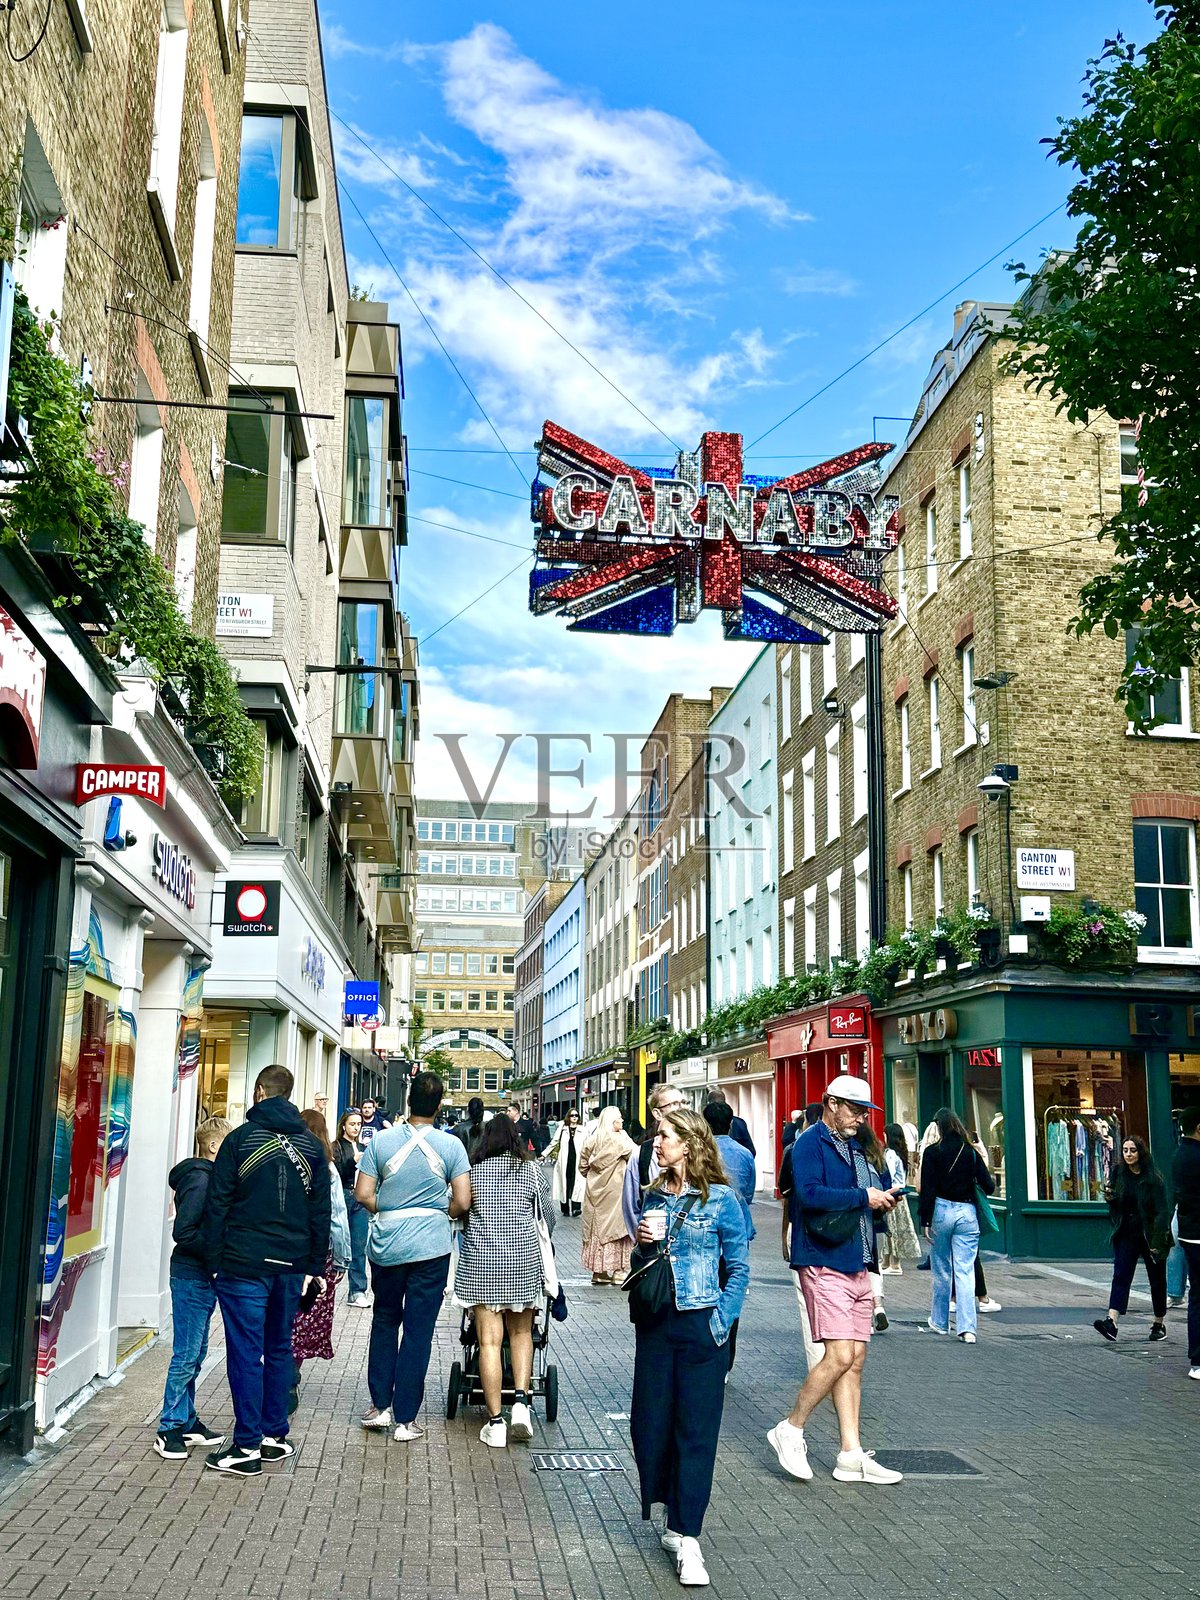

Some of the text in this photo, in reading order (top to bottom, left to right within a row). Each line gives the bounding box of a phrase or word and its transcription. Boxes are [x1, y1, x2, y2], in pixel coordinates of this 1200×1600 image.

[551, 472, 900, 550] CARNABY
[217, 596, 241, 606] NTON
[217, 607, 252, 617] EET W1
[82, 768, 160, 798] CAMPER
[1021, 852, 1057, 863] GANTON
[152, 833, 193, 905] swatch
[1021, 865, 1071, 876] STREET W1
[227, 922, 267, 932] swatch
[831, 1012, 862, 1029] Ray-Ban
